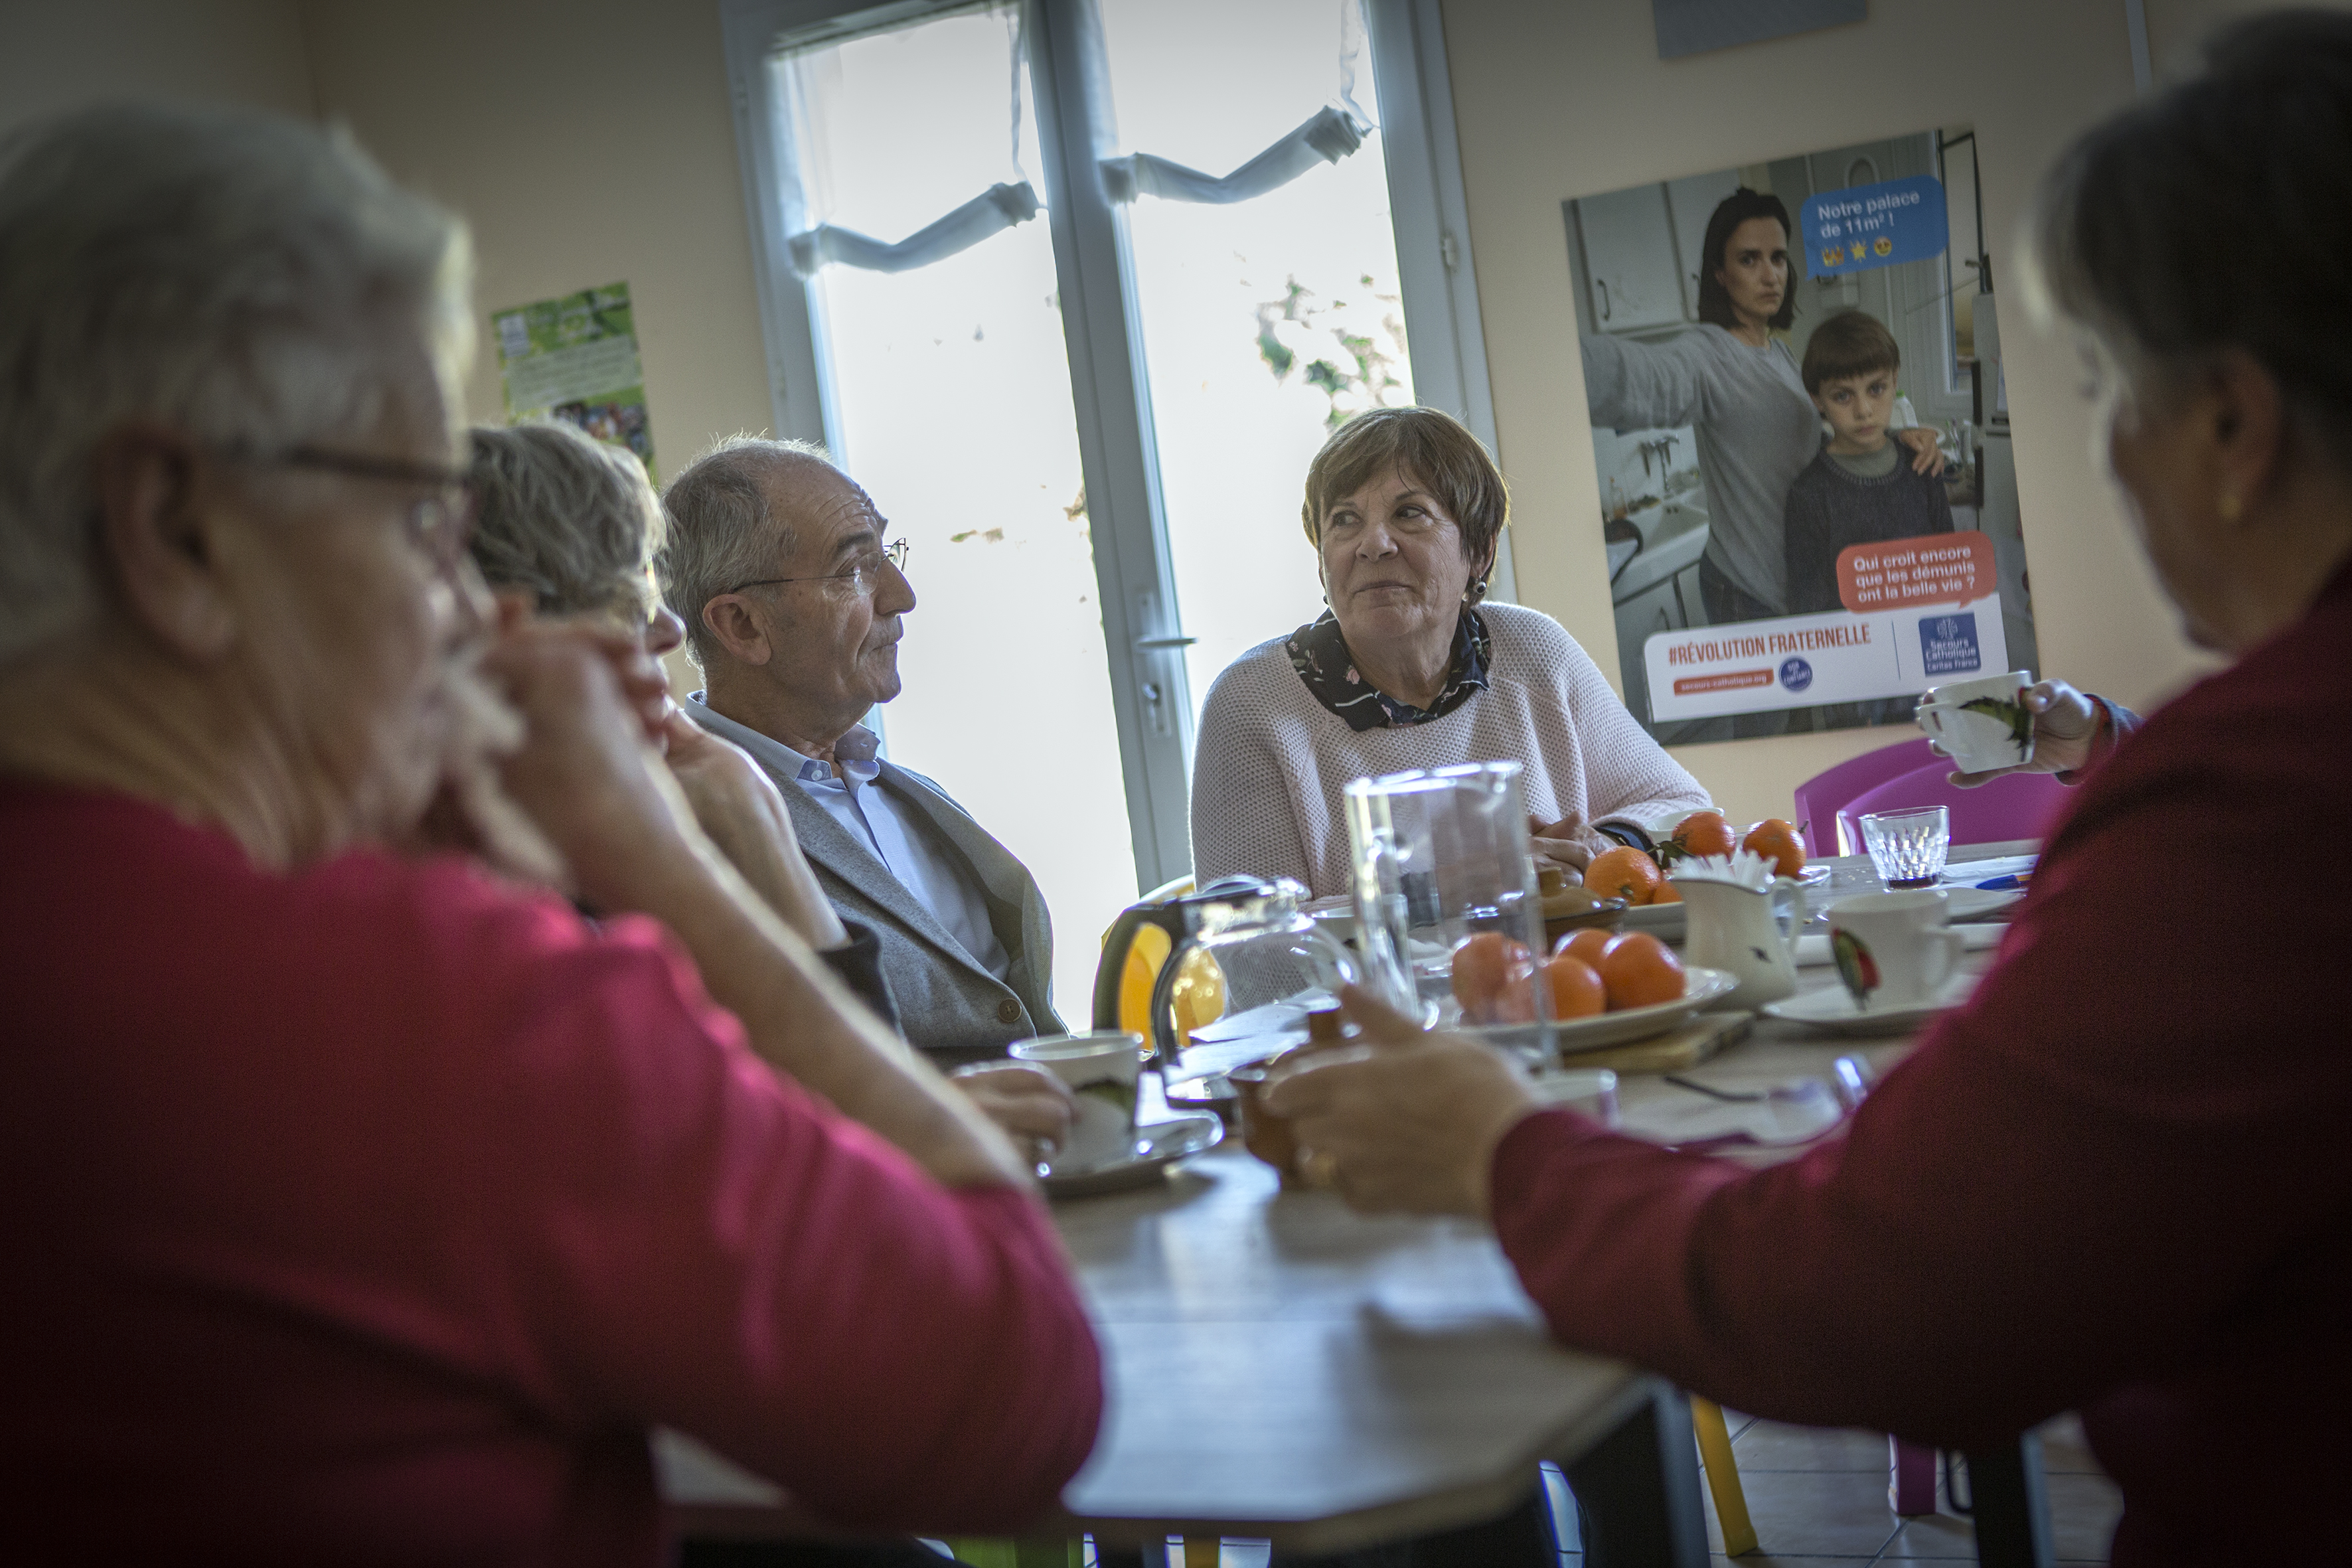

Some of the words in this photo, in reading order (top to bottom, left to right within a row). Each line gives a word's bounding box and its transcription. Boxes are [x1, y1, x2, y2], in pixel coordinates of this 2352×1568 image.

[1818, 200, 1862, 220] Notre
[1866, 191, 1920, 215] palace
[1820, 223, 1841, 238] de
[1889, 210, 1894, 226] !
[1853, 554, 1879, 572] Qui
[1883, 550, 1917, 568] croit
[1921, 546, 1971, 563] encore
[1856, 572, 1883, 589] que
[1887, 569, 1908, 584] les
[1913, 561, 1975, 580] démunis
[1859, 587, 1882, 603] ont
[1885, 585, 1898, 599] la
[1903, 581, 1937, 597] belle
[1942, 578, 1962, 592] vie
[1967, 574, 1975, 589] ?
[1669, 635, 1766, 666] #RÉVOLUTION
[1769, 623, 1871, 654] FRATERNELLE
[1926, 646, 1976, 661] Catholique
[1930, 638, 1969, 651] Secours
